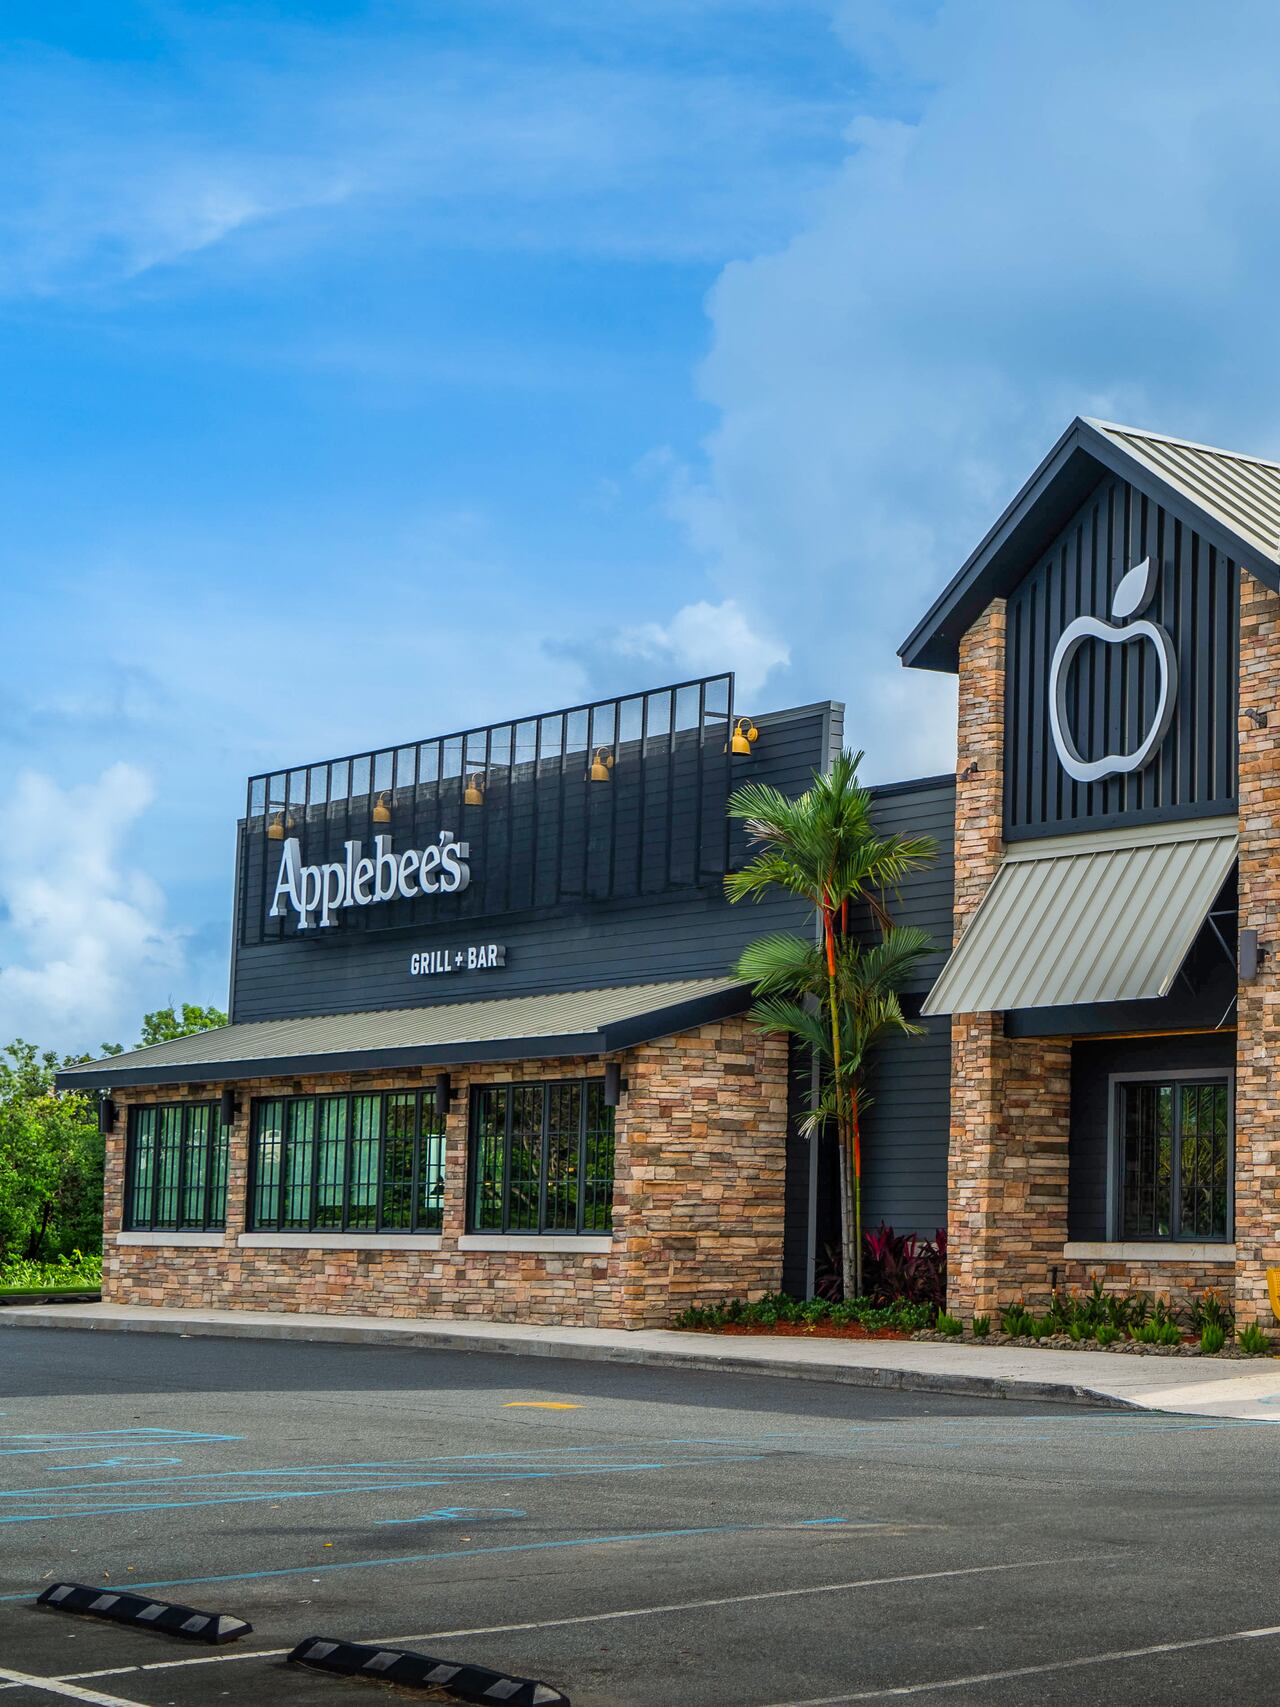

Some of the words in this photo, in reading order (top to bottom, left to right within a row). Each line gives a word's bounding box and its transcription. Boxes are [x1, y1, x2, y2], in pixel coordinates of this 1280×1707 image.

[270, 831, 469, 928] Applebee's
[411, 950, 452, 975] GRILL
[467, 944, 498, 969] BAR
